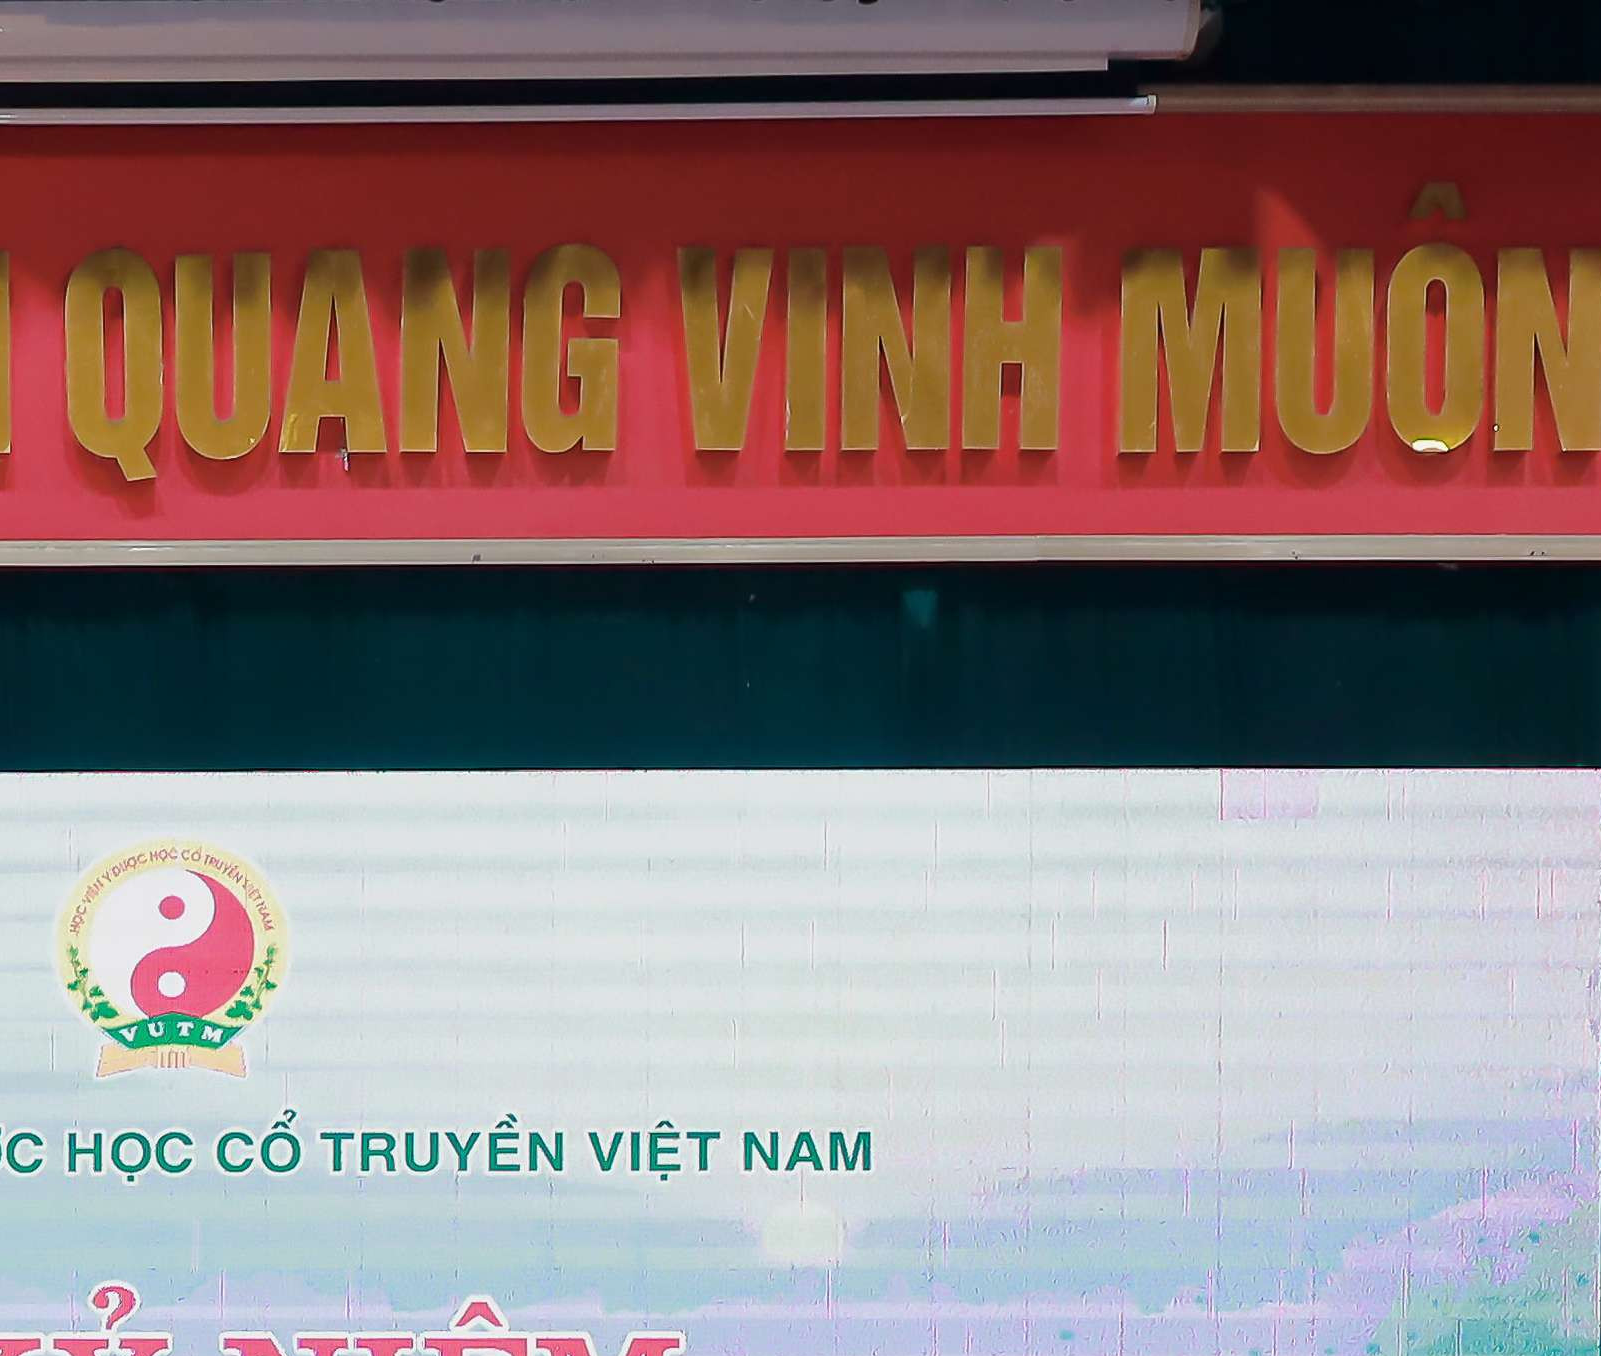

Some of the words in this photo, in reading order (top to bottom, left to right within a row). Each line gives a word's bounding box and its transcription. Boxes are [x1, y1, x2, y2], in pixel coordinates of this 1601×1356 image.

[64, 244, 622, 482] QUANG
[680, 244, 1063, 452] VINH
[67, 1130, 194, 1183] HỌC
[216, 1108, 302, 1174] CỔ
[320, 1113, 565, 1173] TRUYỀN
[589, 1119, 721, 1182] VIỆT
[743, 1130, 872, 1172] NAM
